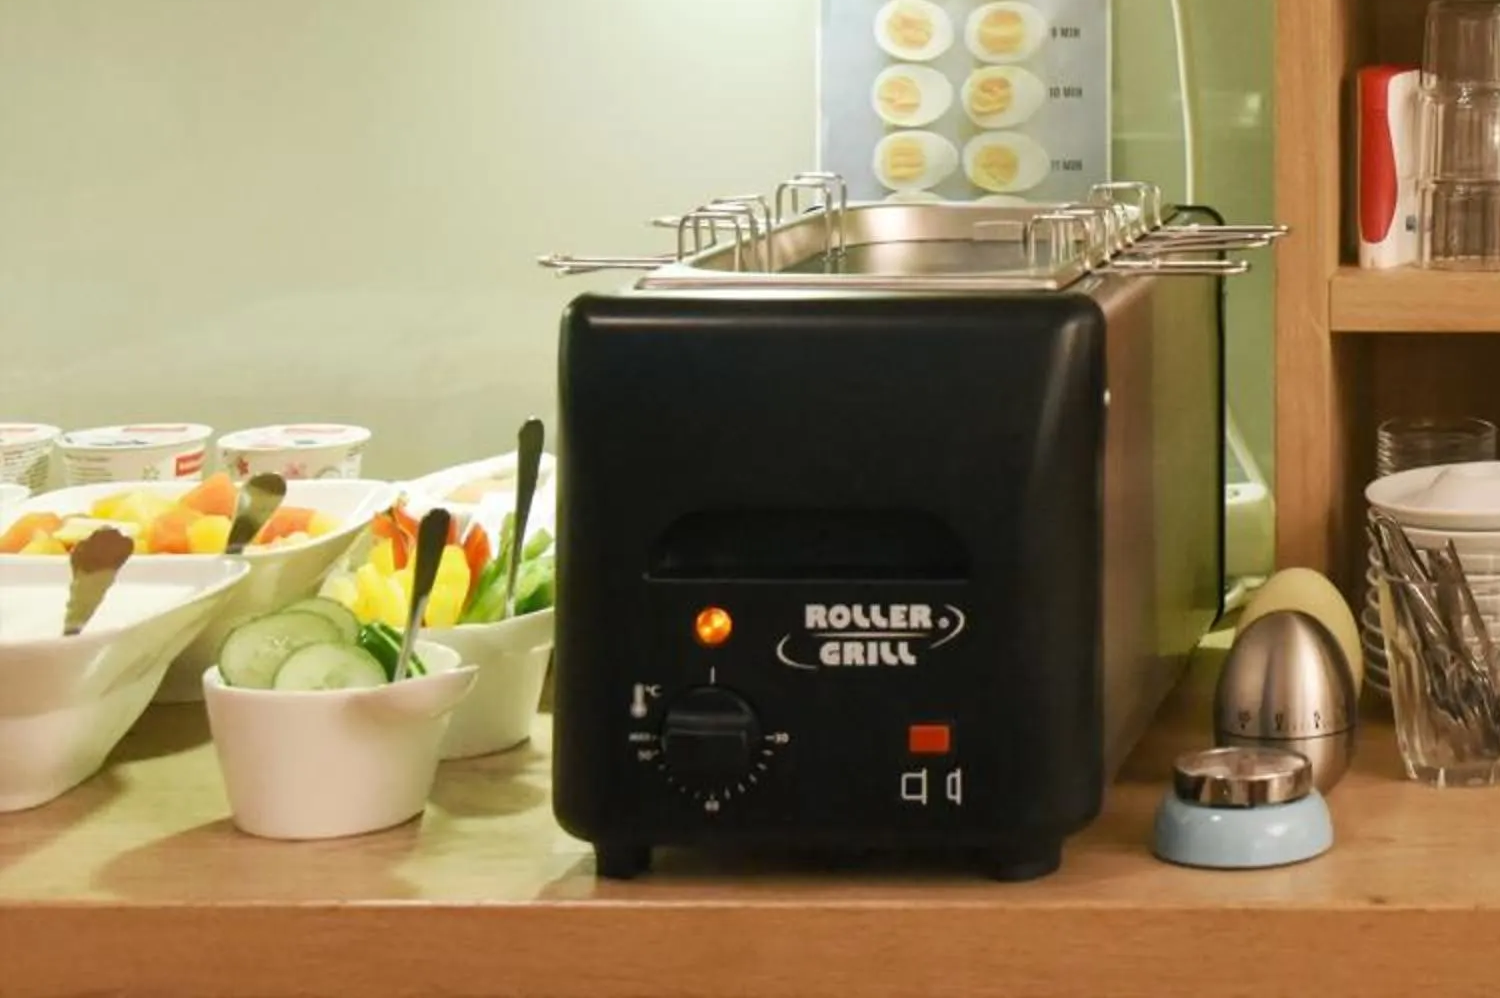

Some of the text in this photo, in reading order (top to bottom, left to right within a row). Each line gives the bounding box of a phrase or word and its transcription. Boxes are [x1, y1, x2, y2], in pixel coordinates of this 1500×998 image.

[1060, 26, 1080, 38] MIN
[1063, 87, 1082, 98] MIN
[1063, 159, 1082, 171] MIN
[805, 604, 933, 629] ROLLER
[819, 641, 917, 666] GRILL
